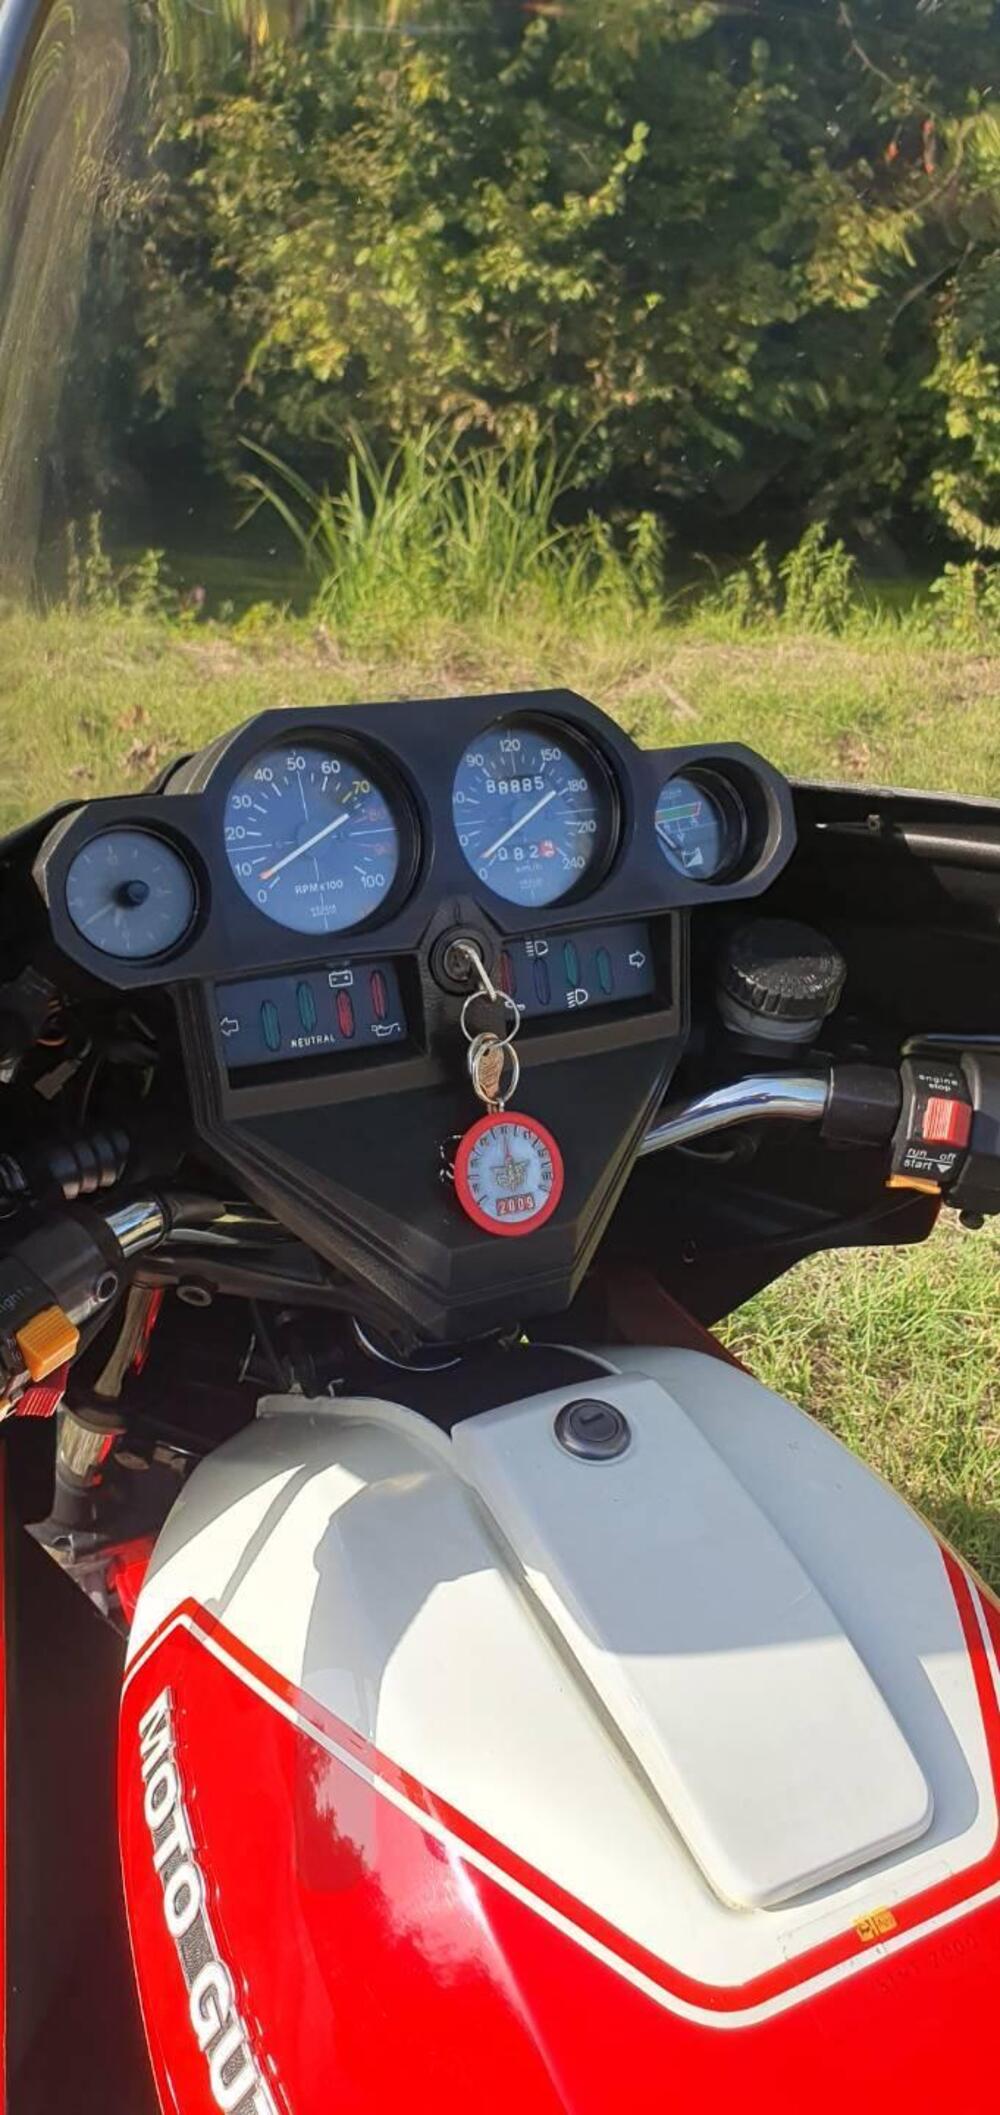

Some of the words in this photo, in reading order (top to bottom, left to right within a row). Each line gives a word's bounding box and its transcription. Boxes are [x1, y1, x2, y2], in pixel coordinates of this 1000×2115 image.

[500, 739, 521, 752] 120
[466, 754, 484, 767] 90
[541, 748, 562, 761] 150
[286, 756, 306, 771] 50
[321, 760, 341, 774] 60
[254, 768, 273, 782] 40
[352, 780, 370, 794] 70
[567, 779, 588, 792] 180
[232, 795, 251, 809] 30
[225, 826, 246, 841] 20
[577, 821, 597, 834] 210
[236, 863, 252, 876] 10
[562, 856, 586, 870] 240
[361, 873, 385, 888] 100
[479, 868, 488, 881] 0
[257, 889, 268, 903] 0
[291, 1034, 335, 1048] NEUTRAL
[919, 1074, 958, 1086] engine
[928, 1083, 952, 1092] stop
[907, 1147, 928, 1158] run
[939, 1153, 956, 1162] off
[904, 1158, 933, 1171] start
[138, 1686, 204, 1939] MOTO
